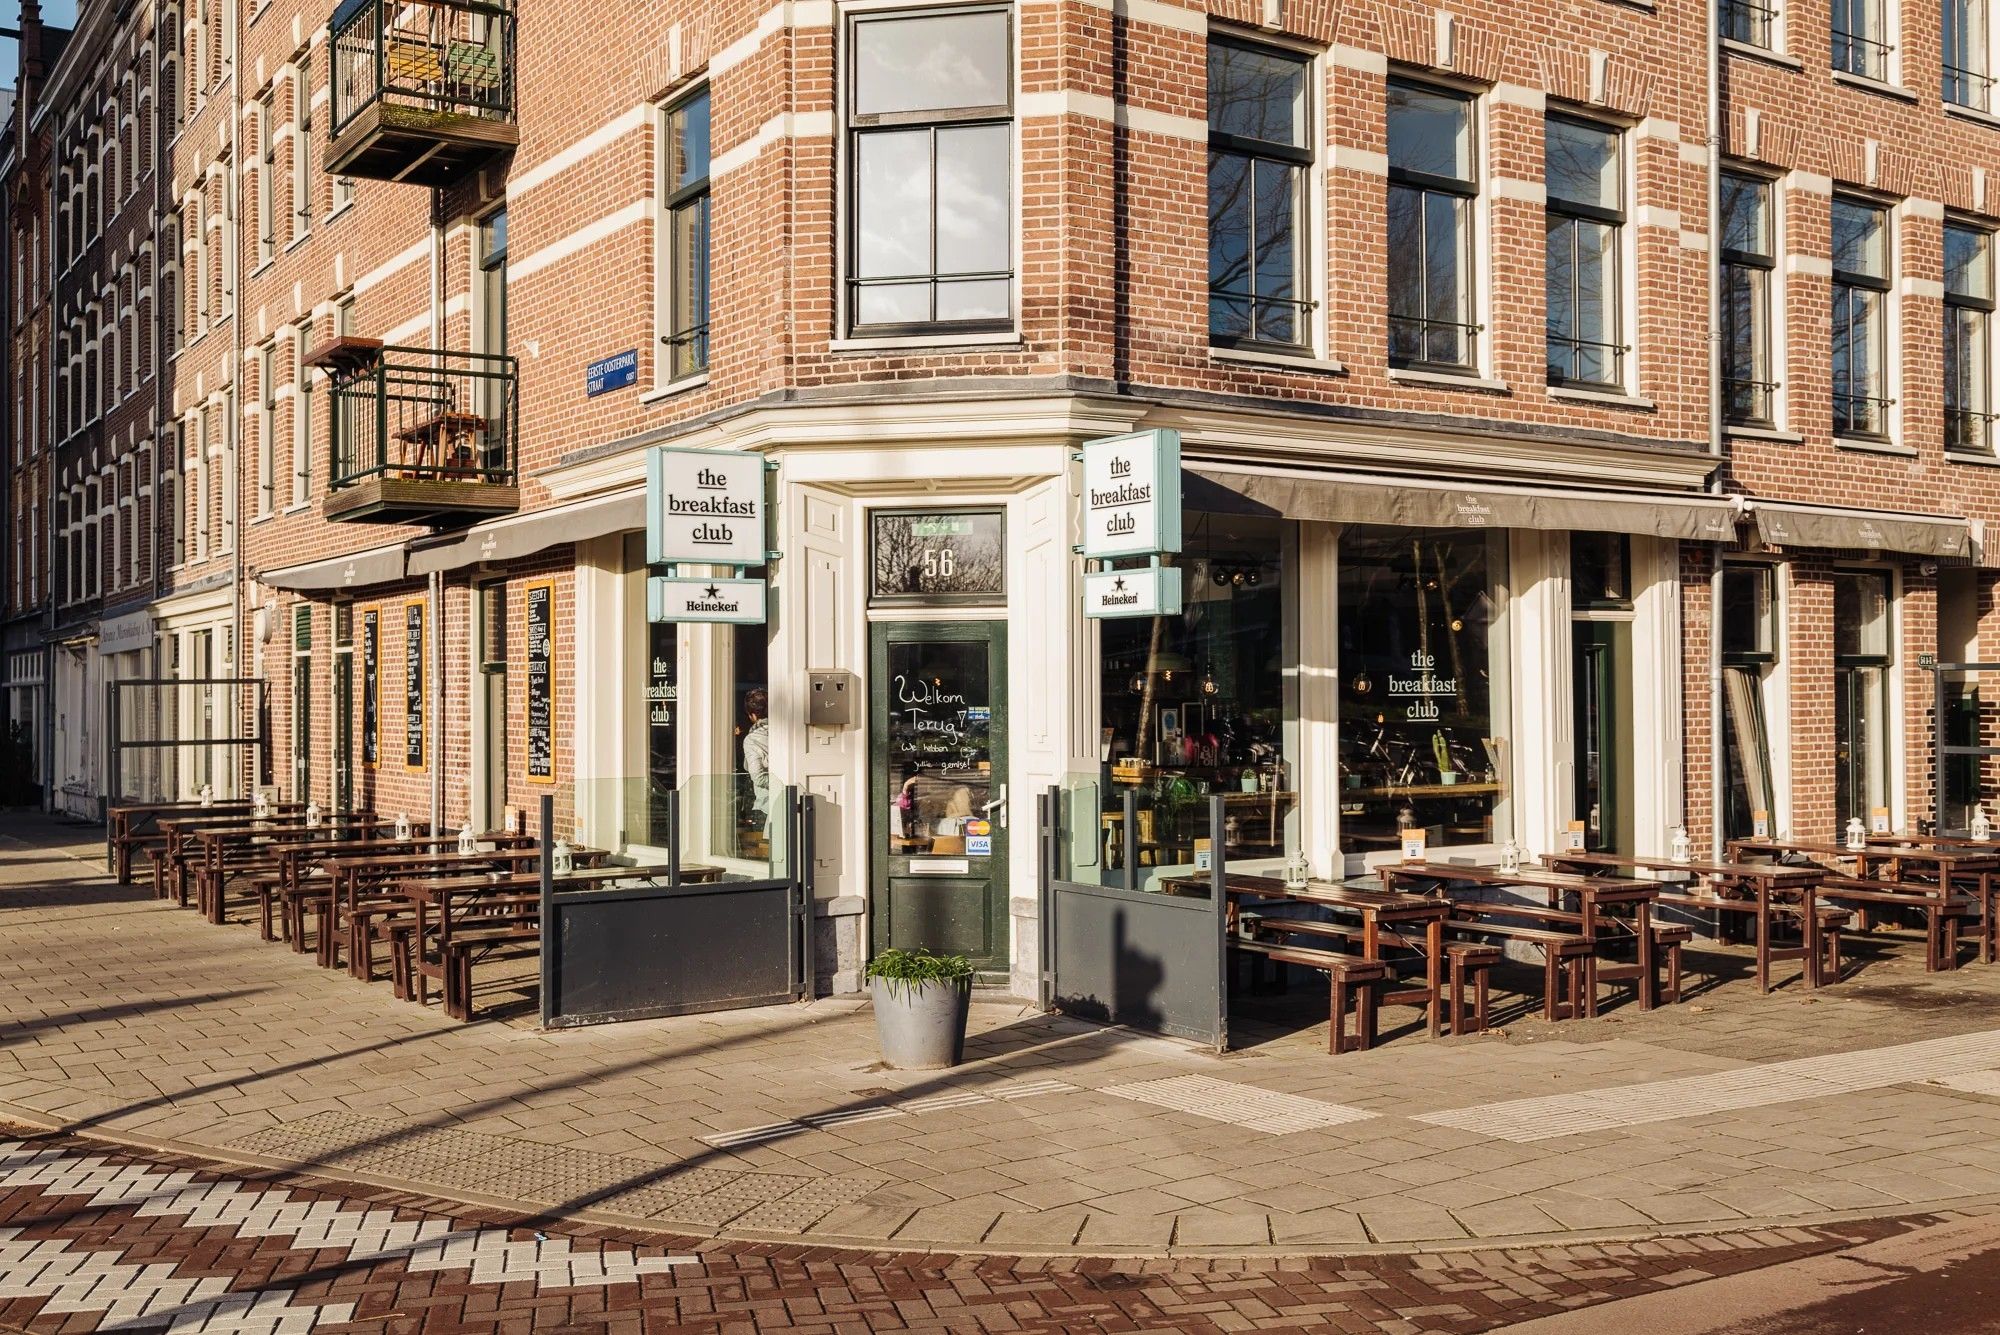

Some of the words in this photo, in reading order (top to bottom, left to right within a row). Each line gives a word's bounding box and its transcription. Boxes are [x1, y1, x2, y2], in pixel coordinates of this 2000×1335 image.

[588, 363, 604, 379] EERSTE
[604, 353, 635, 374] OOSTERPARK
[588, 377, 604, 394] STRAAT
[1110, 456, 1131, 475] the
[697, 468, 727, 486] the
[1091, 483, 1151, 506] breakfast
[669, 494, 756, 515] breakfast
[1107, 512, 1135, 532] club
[692, 523, 733, 541] club
[924, 549, 953, 577] 56
[686, 601, 739, 612] Heineken
[1102, 593, 1138, 606] Heineken
[653, 656, 667, 673] the
[1411, 649, 1435, 667] the
[641, 681, 678, 698] breakfas
[894, 675, 965, 705] Welkom
[1388, 674, 1457, 693] breakfast
[651, 705, 669, 722] club
[1407, 700, 1439, 718] club
